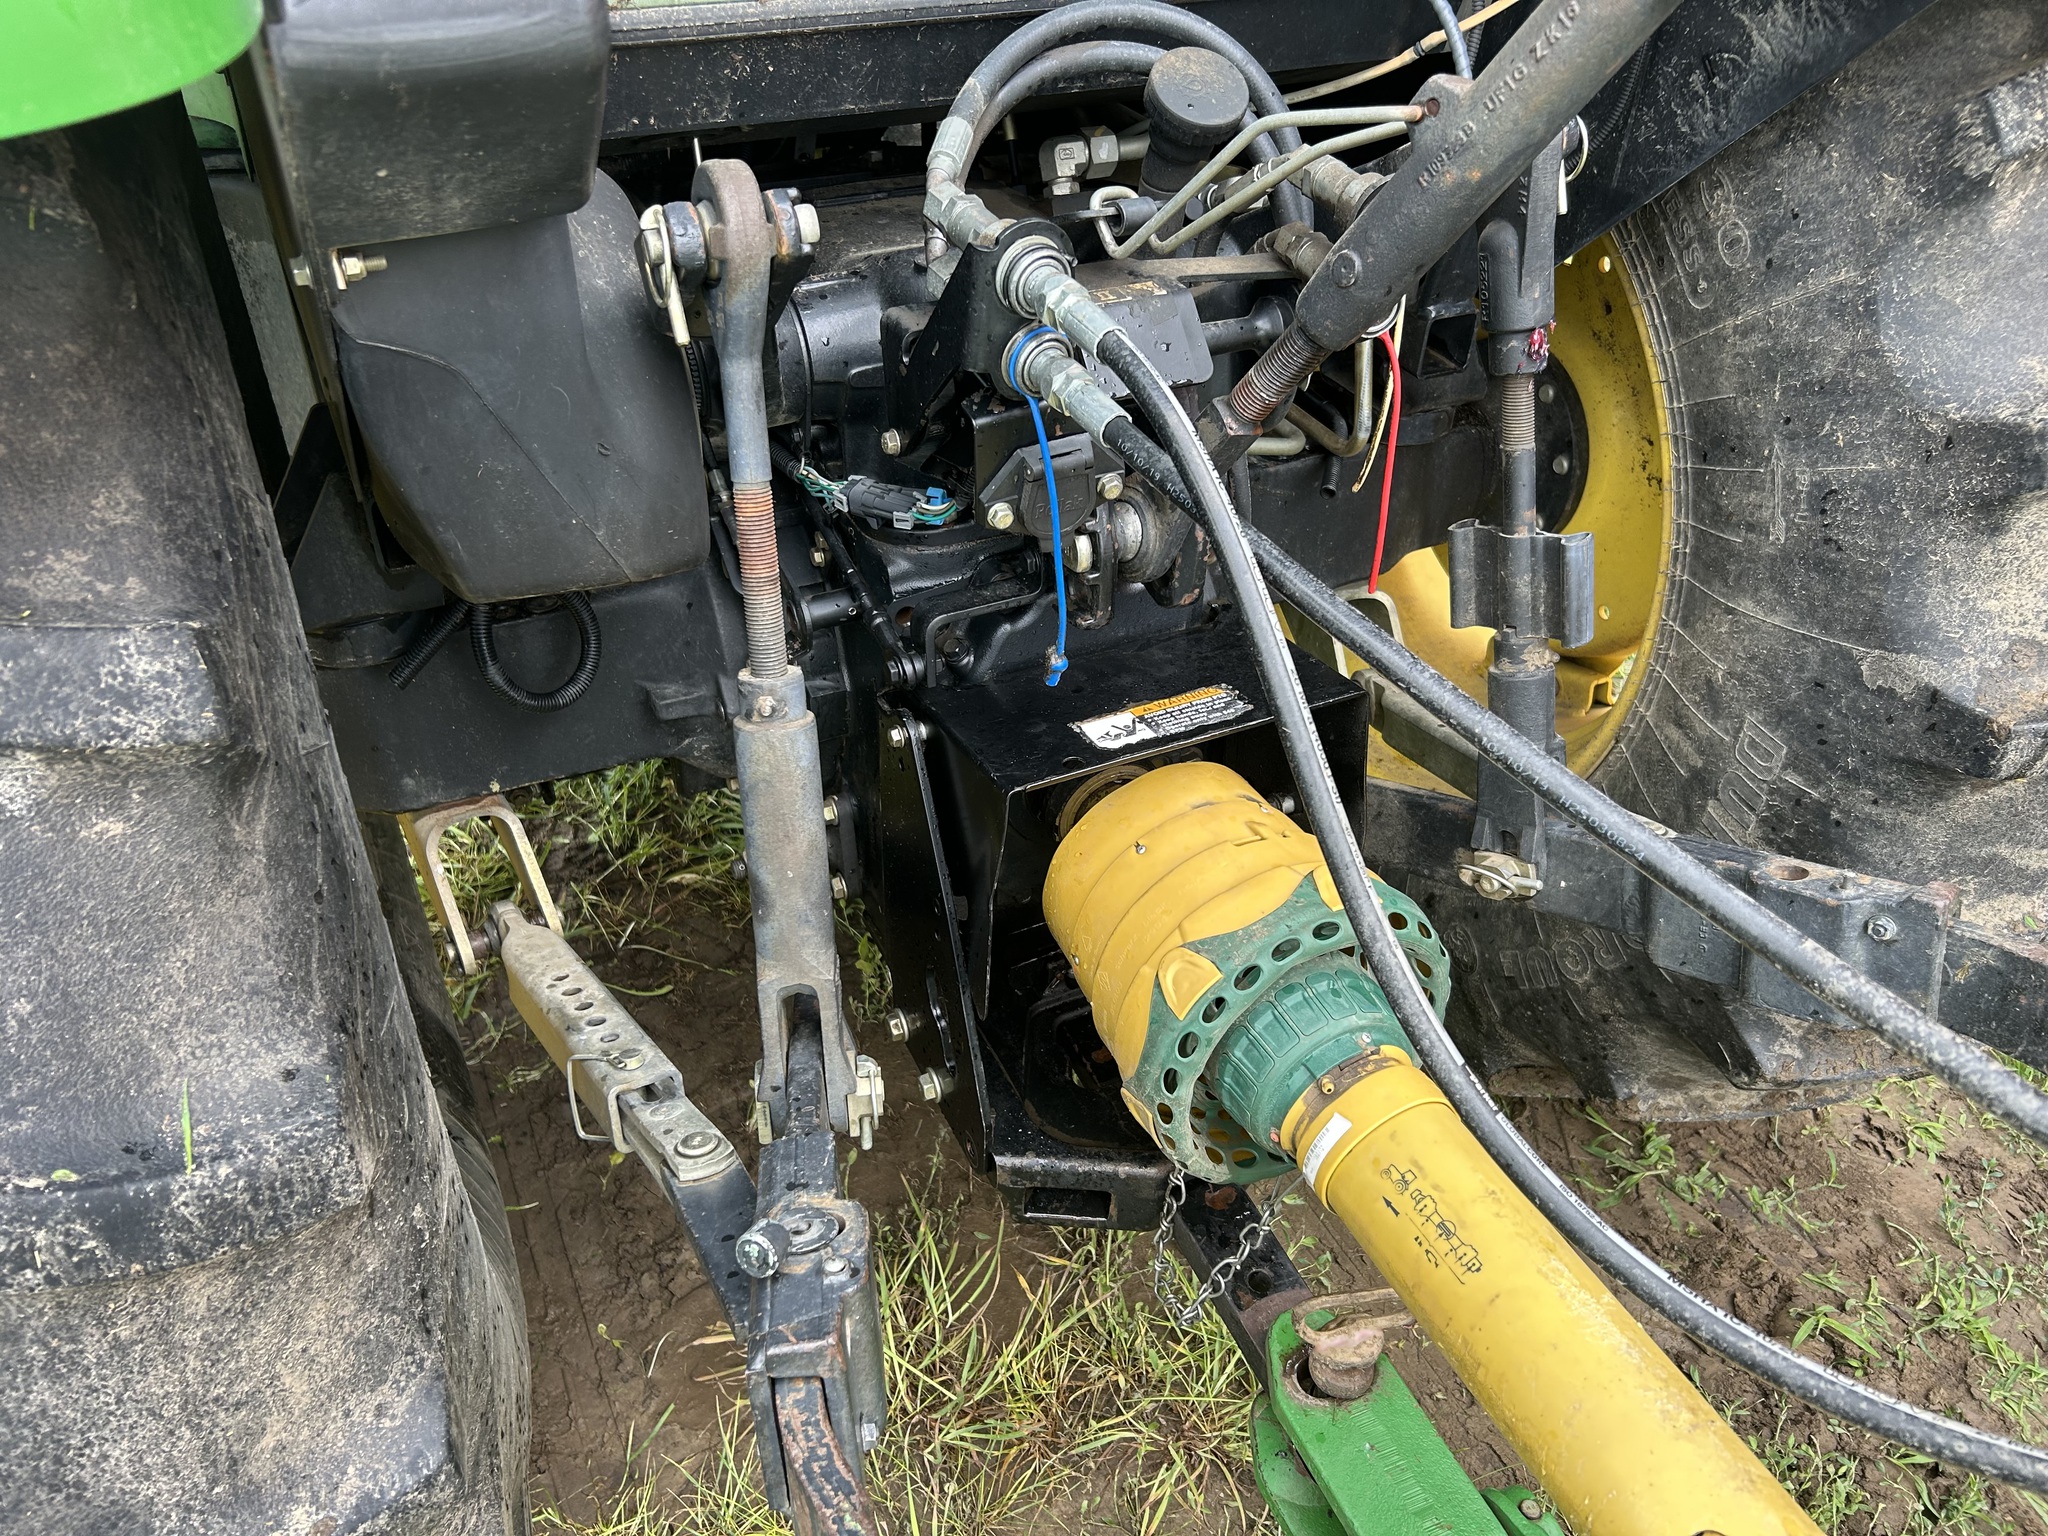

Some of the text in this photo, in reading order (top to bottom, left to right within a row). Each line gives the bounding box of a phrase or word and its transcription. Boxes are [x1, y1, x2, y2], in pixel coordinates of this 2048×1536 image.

[1116, 438, 1161, 481] 10/10/19
[1035, 494, 1084, 519] Polak
[1153, 688, 1218, 708] WARNING
[1468, 1073, 1548, 1171] Parker GLOBALCORE
[1557, 1183, 1575, 1199] ISO
[1667, 1274, 1720, 1314] MSHA
